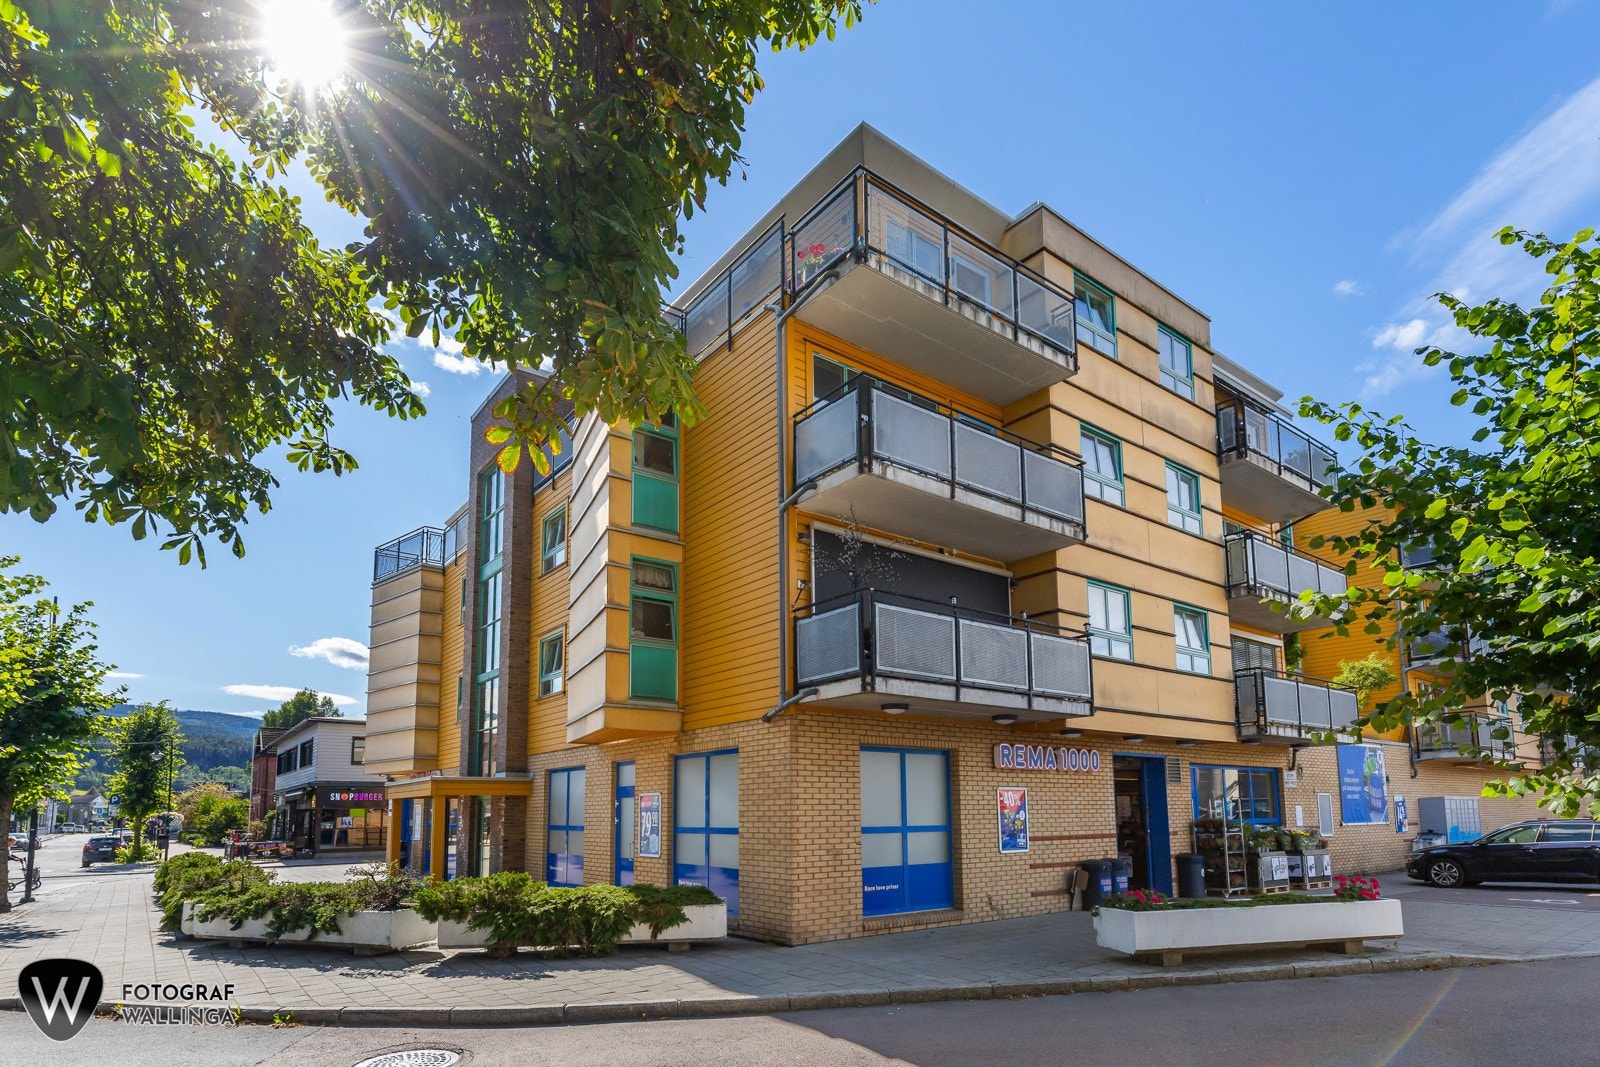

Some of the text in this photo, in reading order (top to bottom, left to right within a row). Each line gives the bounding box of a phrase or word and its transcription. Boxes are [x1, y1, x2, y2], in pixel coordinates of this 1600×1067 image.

[999, 743, 1099, 771] REMA 1000
[111, 795, 119, 804] P
